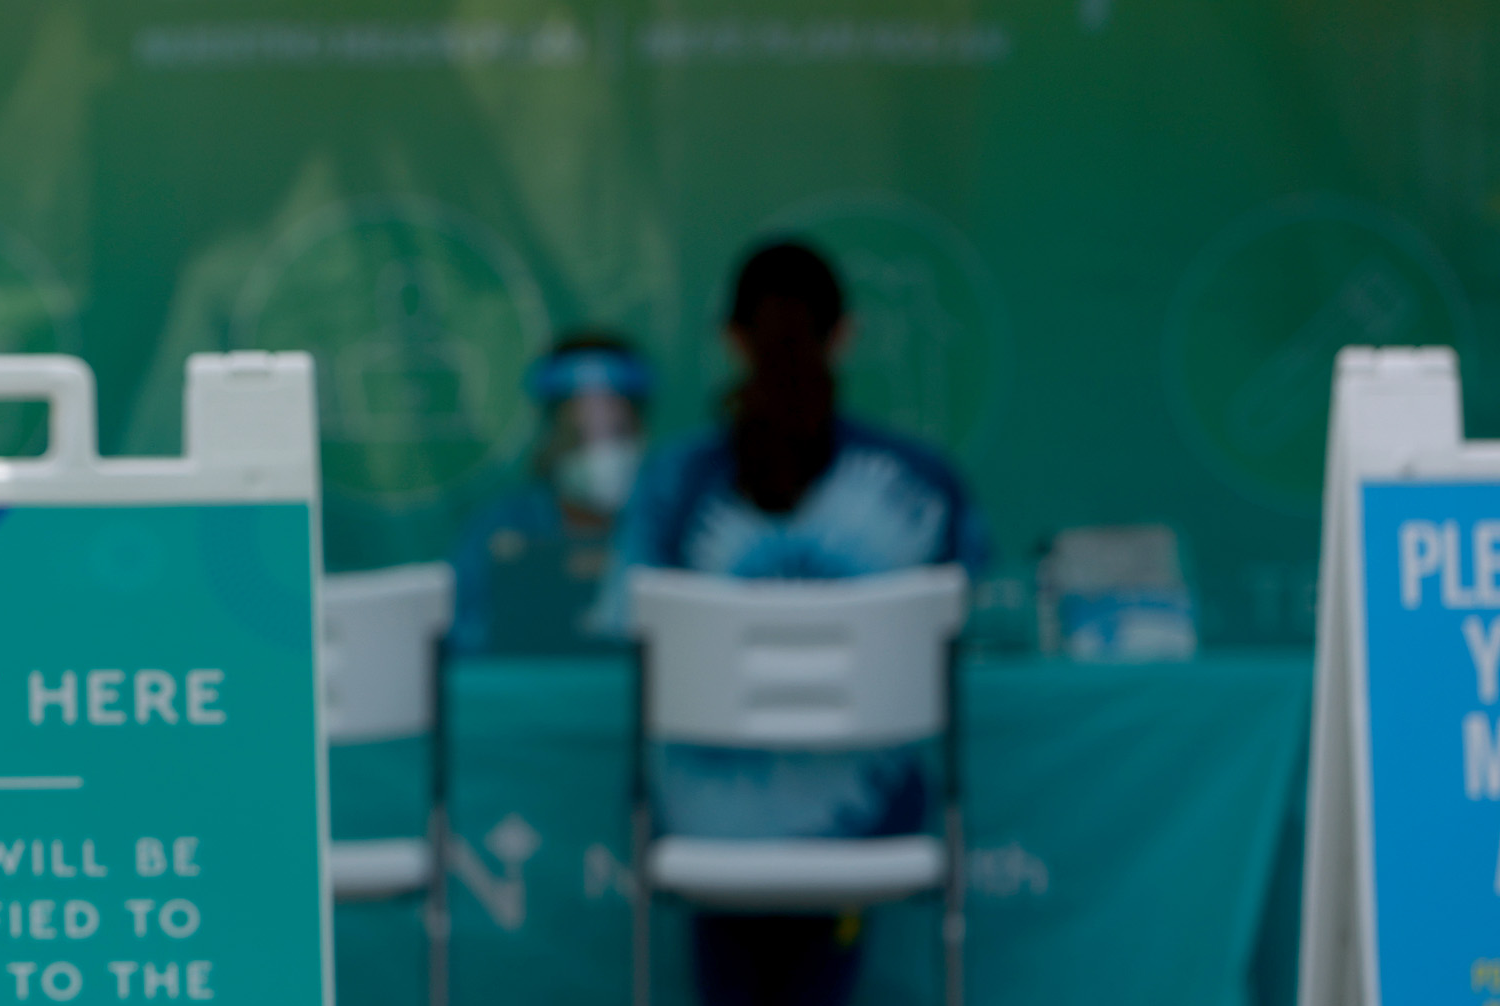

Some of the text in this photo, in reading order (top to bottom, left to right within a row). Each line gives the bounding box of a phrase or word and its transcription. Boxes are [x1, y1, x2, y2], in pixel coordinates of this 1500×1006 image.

[29, 669, 226, 725] HERE
[135, 837, 201, 877] BE
[125, 898, 201, 939] TO
[7, 961, 83, 1002] TO
[109, 960, 215, 1000] THE
